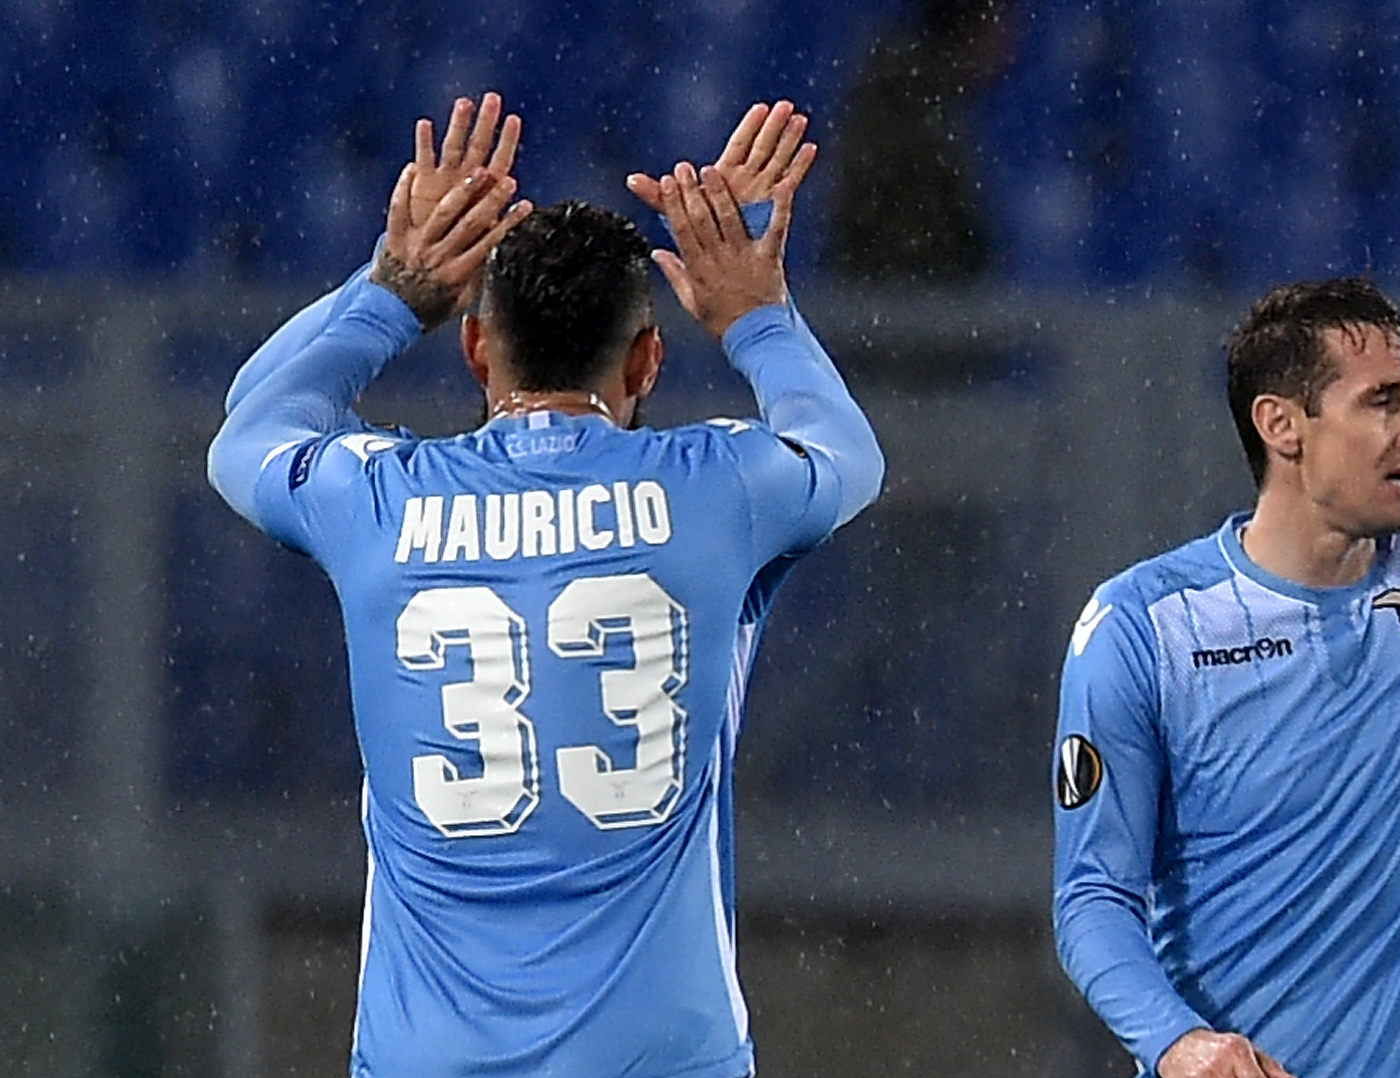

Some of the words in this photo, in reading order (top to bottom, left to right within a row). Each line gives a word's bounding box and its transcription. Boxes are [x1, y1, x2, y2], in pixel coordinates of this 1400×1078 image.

[394, 480, 671, 563] MAURICIO
[1192, 637, 1293, 669] macron
[396, 573, 689, 838] 33
